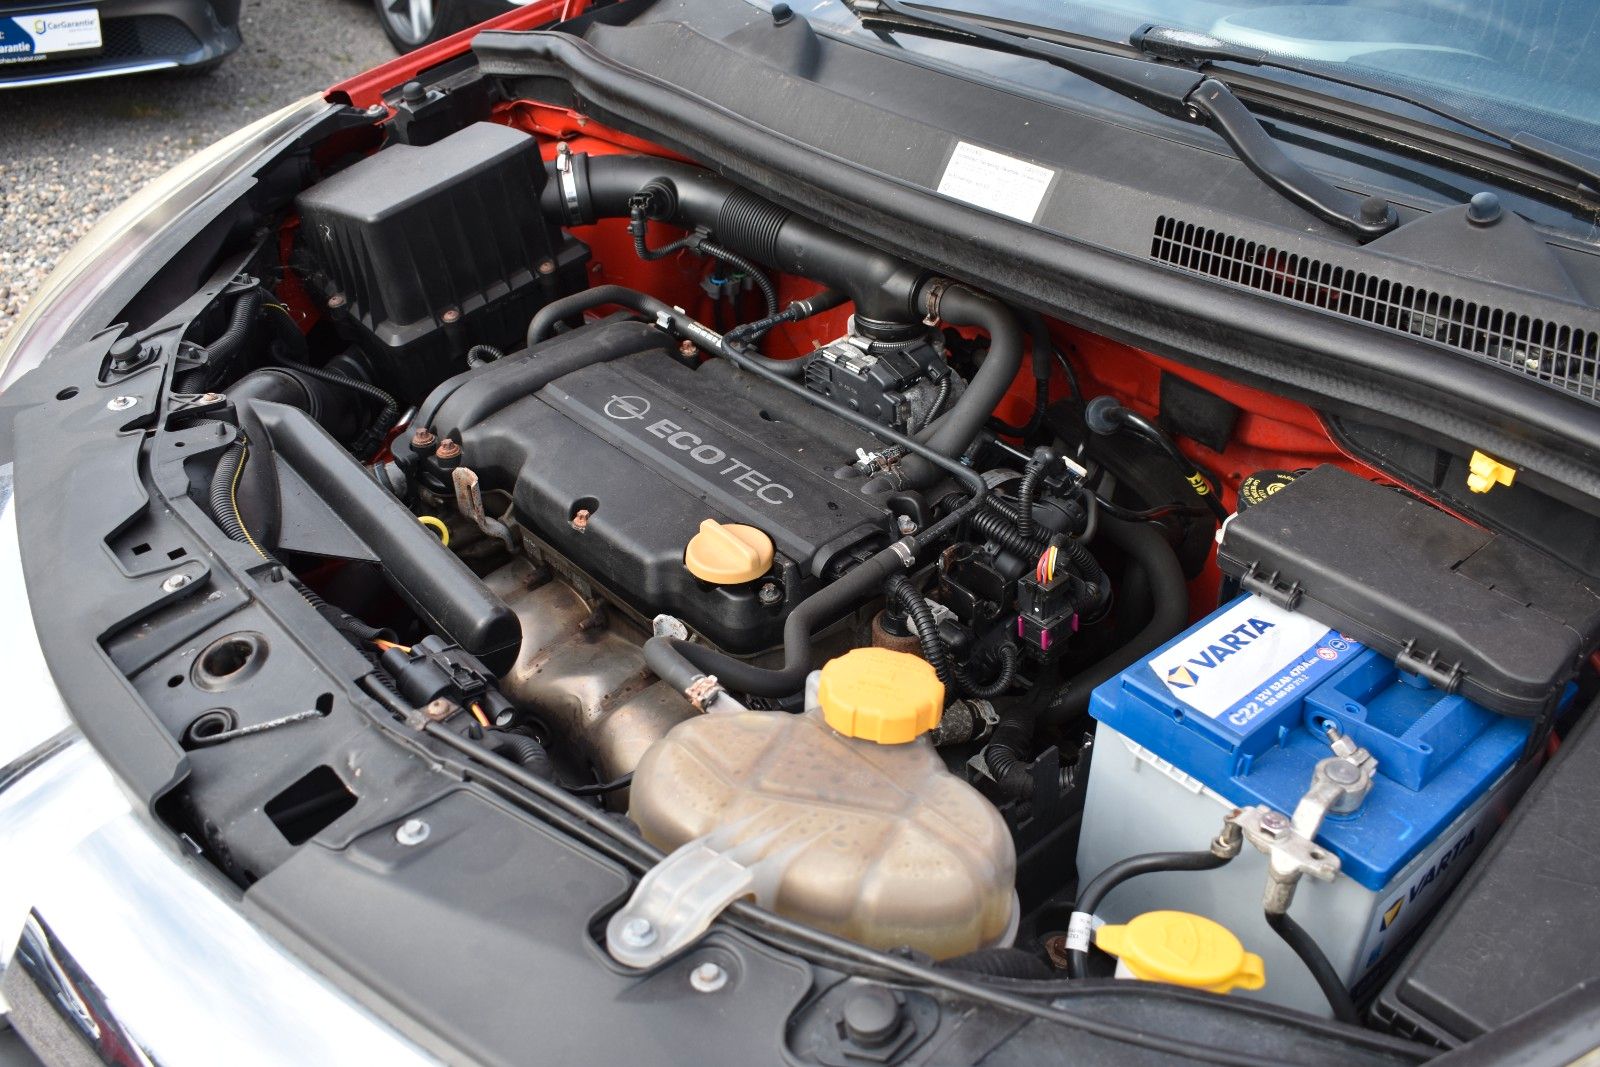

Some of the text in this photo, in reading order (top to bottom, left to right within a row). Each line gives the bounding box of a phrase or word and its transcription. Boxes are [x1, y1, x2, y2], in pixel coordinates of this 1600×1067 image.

[645, 418, 794, 505] ECOTEC
[1187, 617, 1276, 669] VARTA
[1229, 701, 1265, 726] C22
[1255, 688, 1273, 702] 12V
[1269, 676, 1293, 691] 52Ah
[1409, 826, 1477, 903] VARTA
